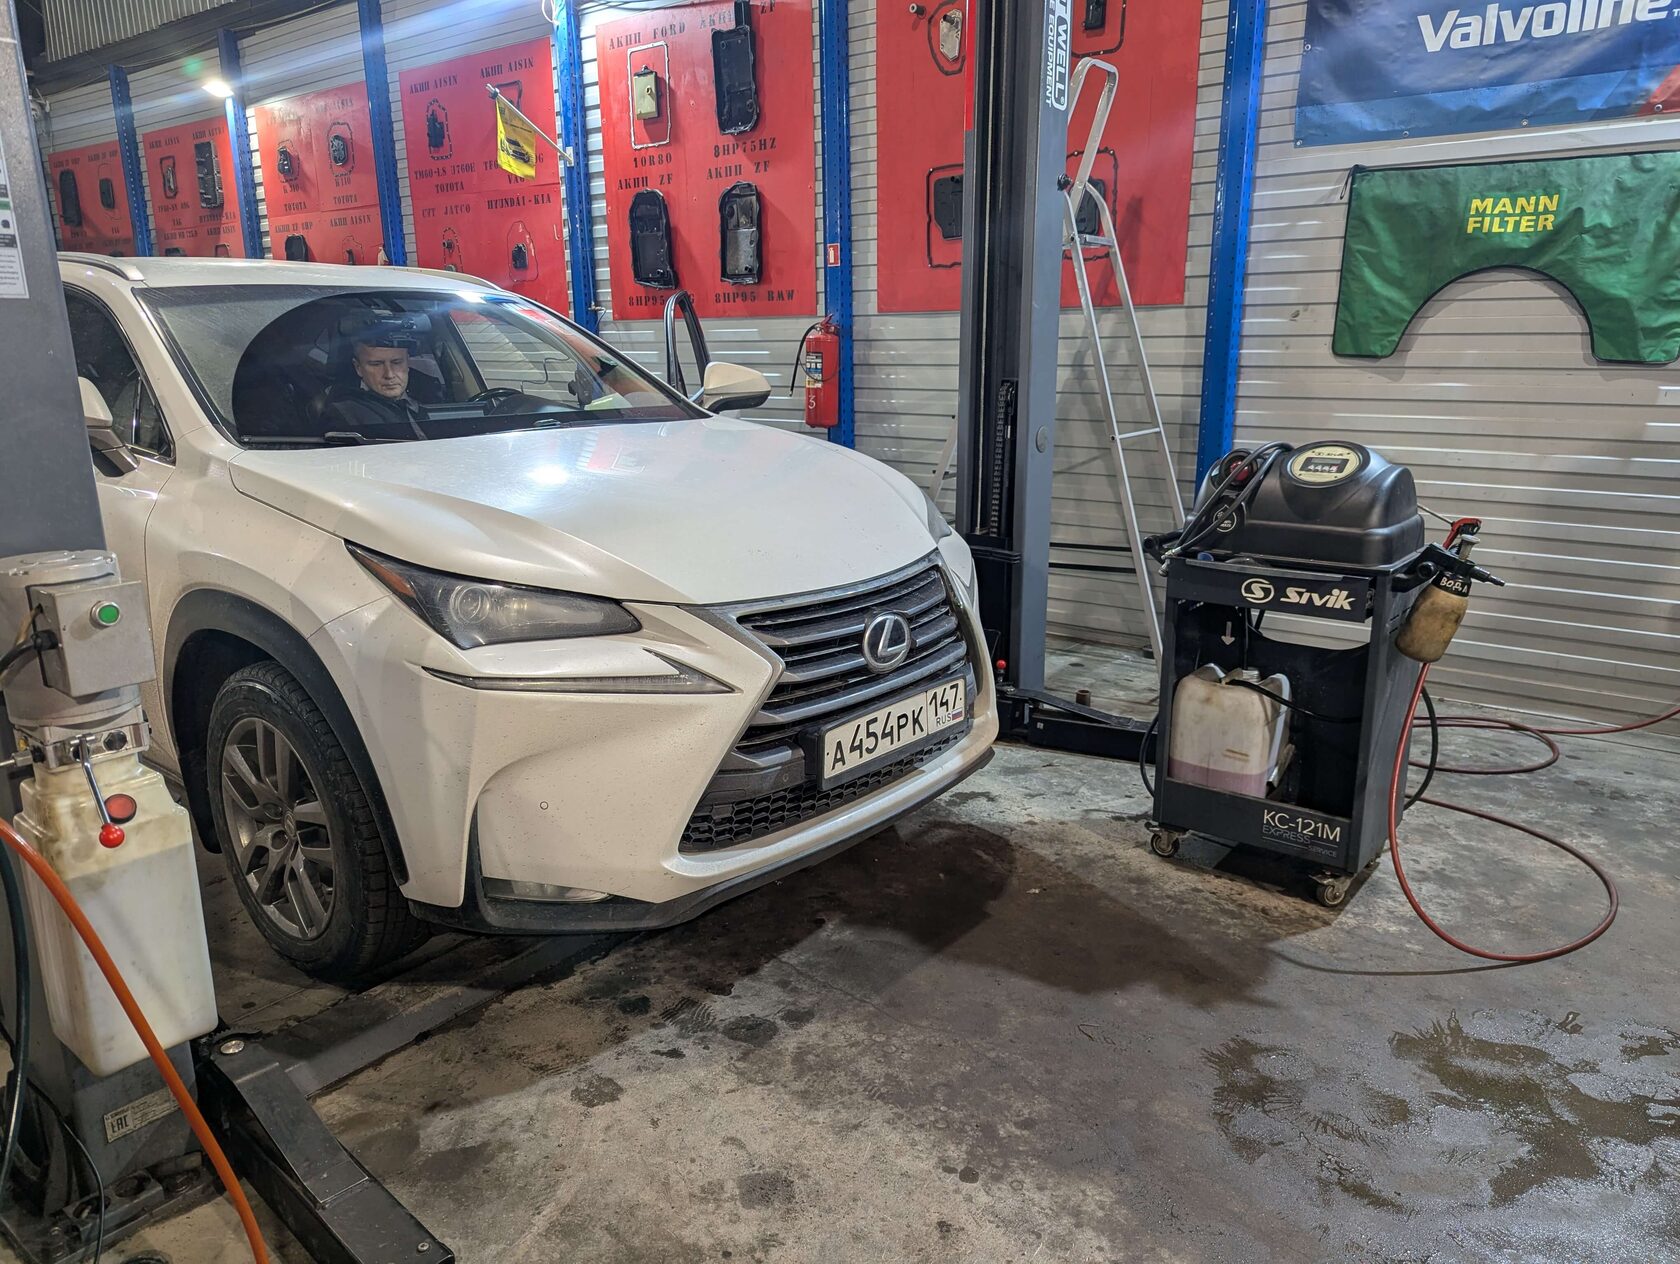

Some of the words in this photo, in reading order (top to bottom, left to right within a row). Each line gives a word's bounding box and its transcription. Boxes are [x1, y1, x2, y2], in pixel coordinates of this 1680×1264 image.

[653, 22, 686, 40] FORD
[507, 57, 534, 72] AISIN
[1046, 14, 1056, 107] EQUIPMENT
[433, 74, 458, 89] AISIN
[633, 152, 672, 168] 10R80
[754, 160, 770, 174] ZF
[659, 173, 673, 186] ZF
[434, 181, 465, 194] TOYOTA
[284, 202, 307, 212] TOYOTA
[333, 194, 358, 205] TOYOTA
[1470, 194, 1559, 215] MANN
[444, 203, 471, 215] JATCO
[350, 214, 371, 226] AISIN
[1466, 214, 1555, 234] FILTER
[628, 294, 665, 306] 8HP95
[715, 291, 757, 304] 8HP95
[767, 289, 795, 301] BMW
[1440, 577, 1468, 594] ВОДА
[929, 683, 960, 717] 147
[936, 712, 952, 727] RUS
[1262, 824, 1311, 844] EXPRESS
[1308, 845, 1337, 858] SERVICE
